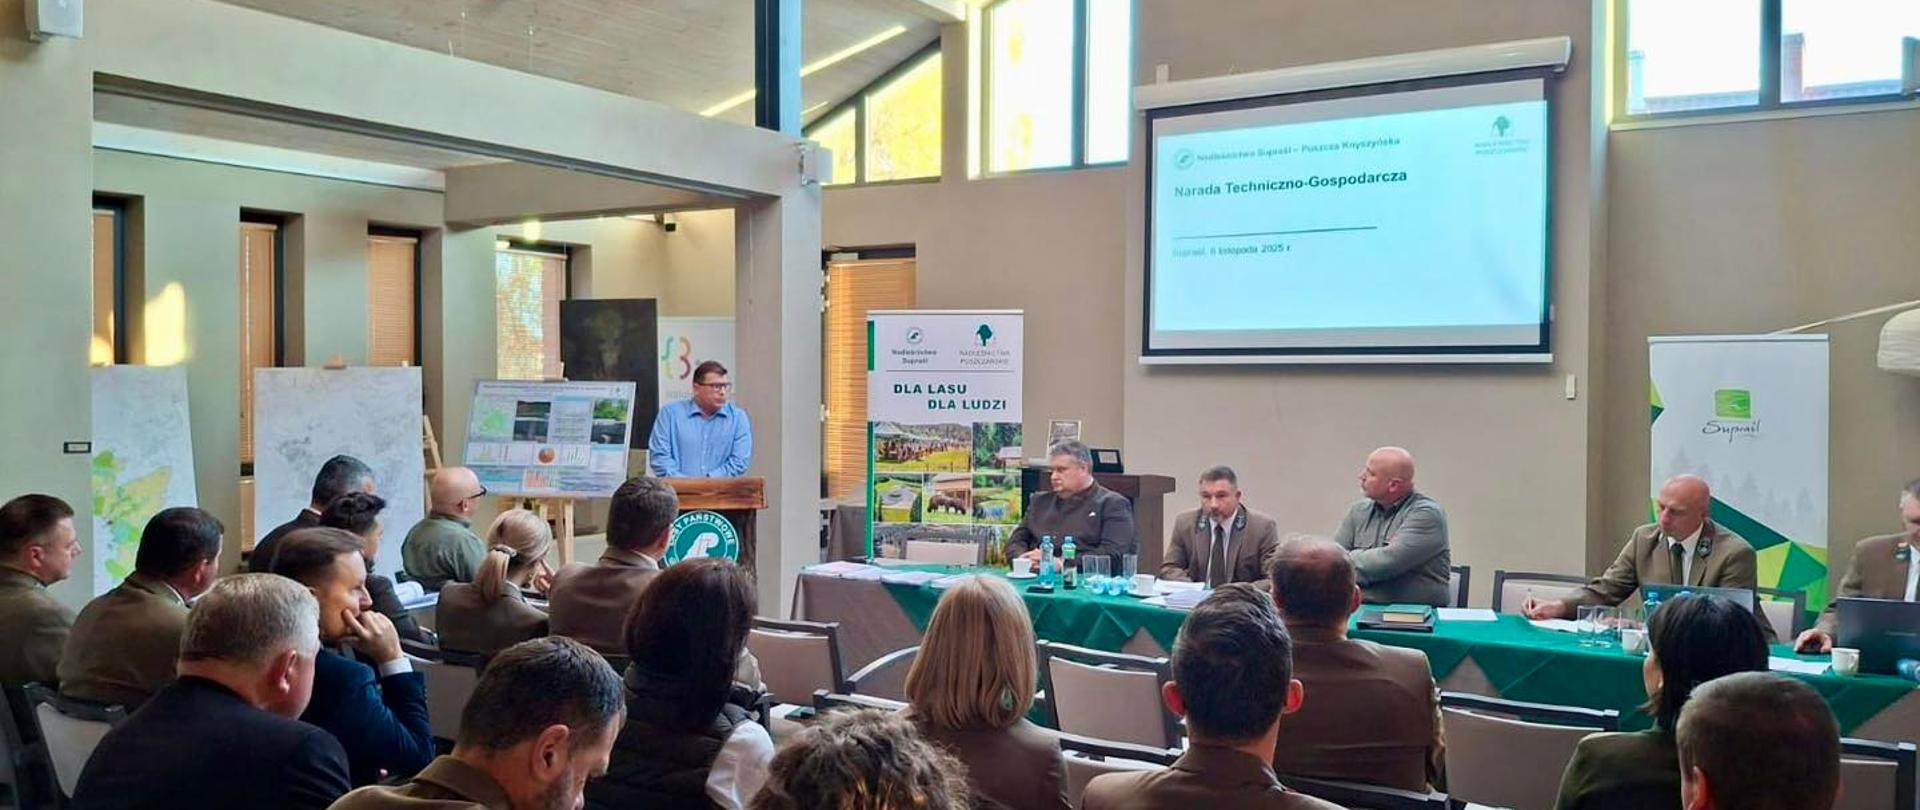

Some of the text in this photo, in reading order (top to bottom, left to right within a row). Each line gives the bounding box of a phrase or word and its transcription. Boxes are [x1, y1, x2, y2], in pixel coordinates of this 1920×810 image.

[1174, 170, 1408, 198] Narada Techniczno-Gospodarcza
[893, 384, 967, 394] DLA LASU
[928, 399, 1006, 410] DLA LUDZI
